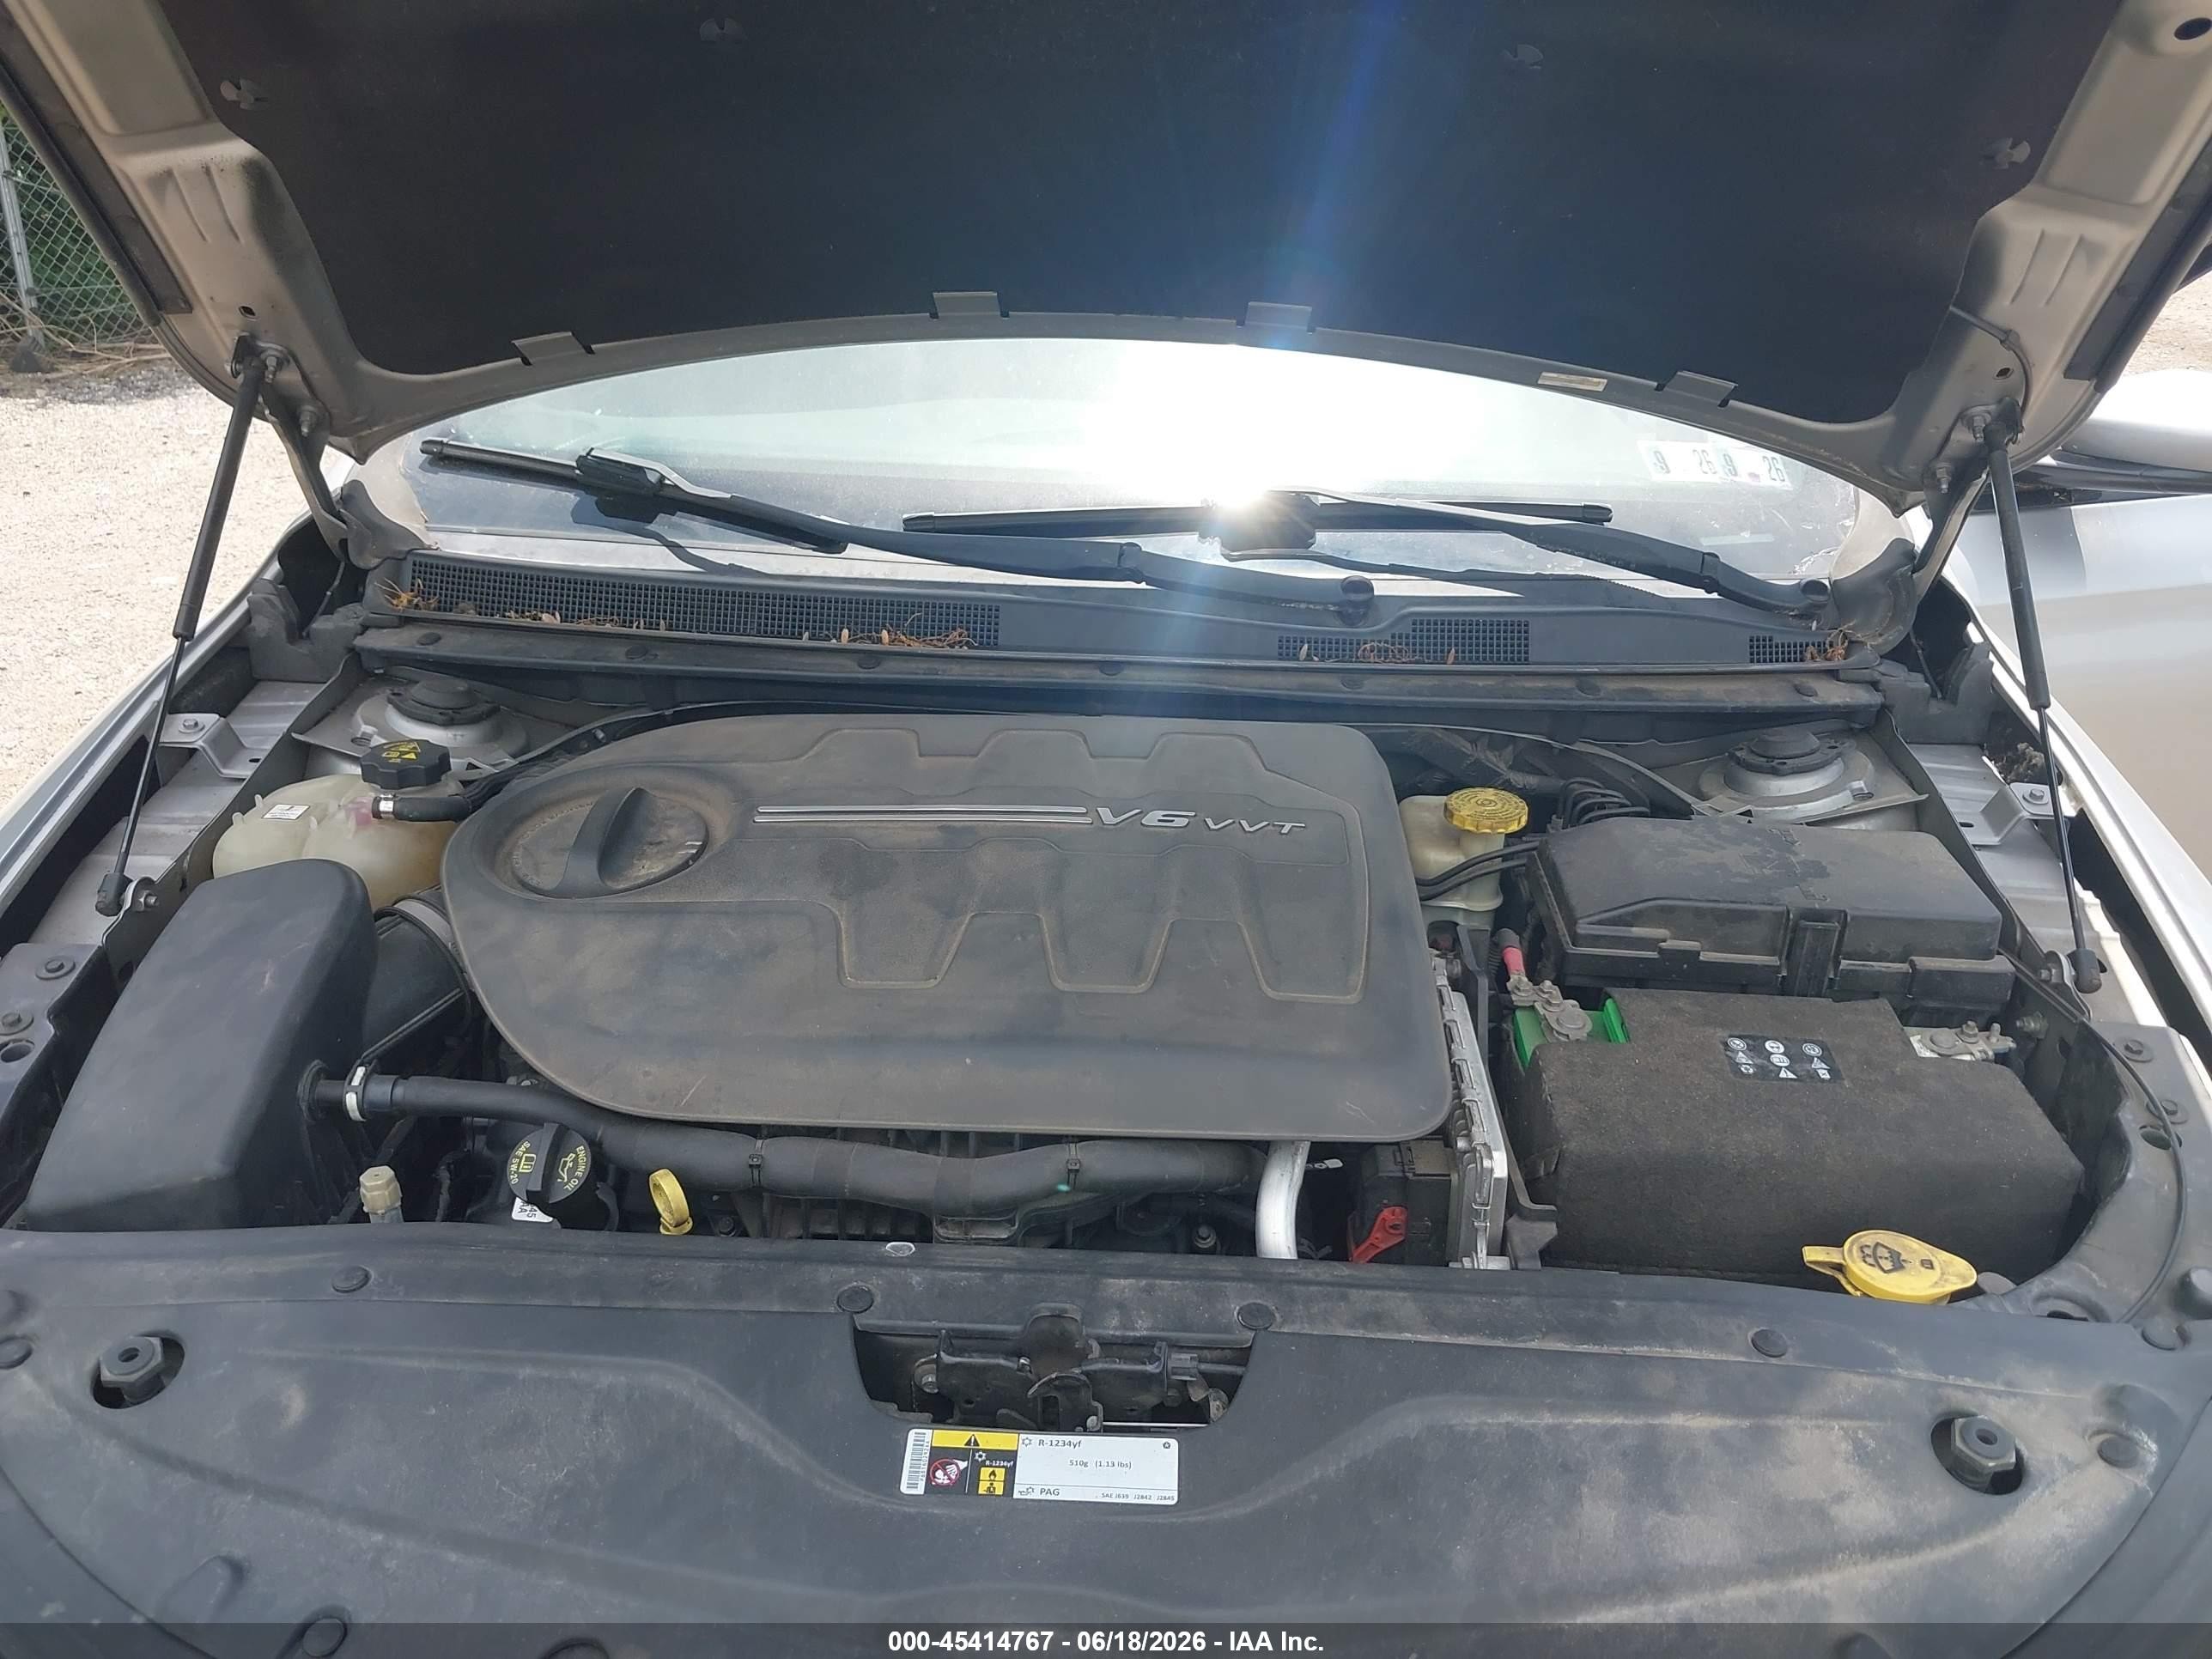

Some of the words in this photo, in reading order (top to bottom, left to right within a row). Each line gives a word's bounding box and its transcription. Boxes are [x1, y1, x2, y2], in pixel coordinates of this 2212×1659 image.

[1763, 455, 1786, 482] 26
[1096, 807, 1196, 827] V6
[1204, 817, 1306, 835] VVT
[515, 1140, 531, 1157] SAE
[575, 1145, 586, 1177] ENGINE
[510, 1158, 520, 1185] 5W-20
[563, 1178, 579, 1191] OIL
[1037, 1438, 1083, 1449] R-1234yf
[1069, 1460, 1089, 1468] 510g
[1095, 1460, 1115, 1468] (1.13
[1117, 1461, 1133, 1469] lbs)
[1040, 1487, 1060, 1497] PAG
